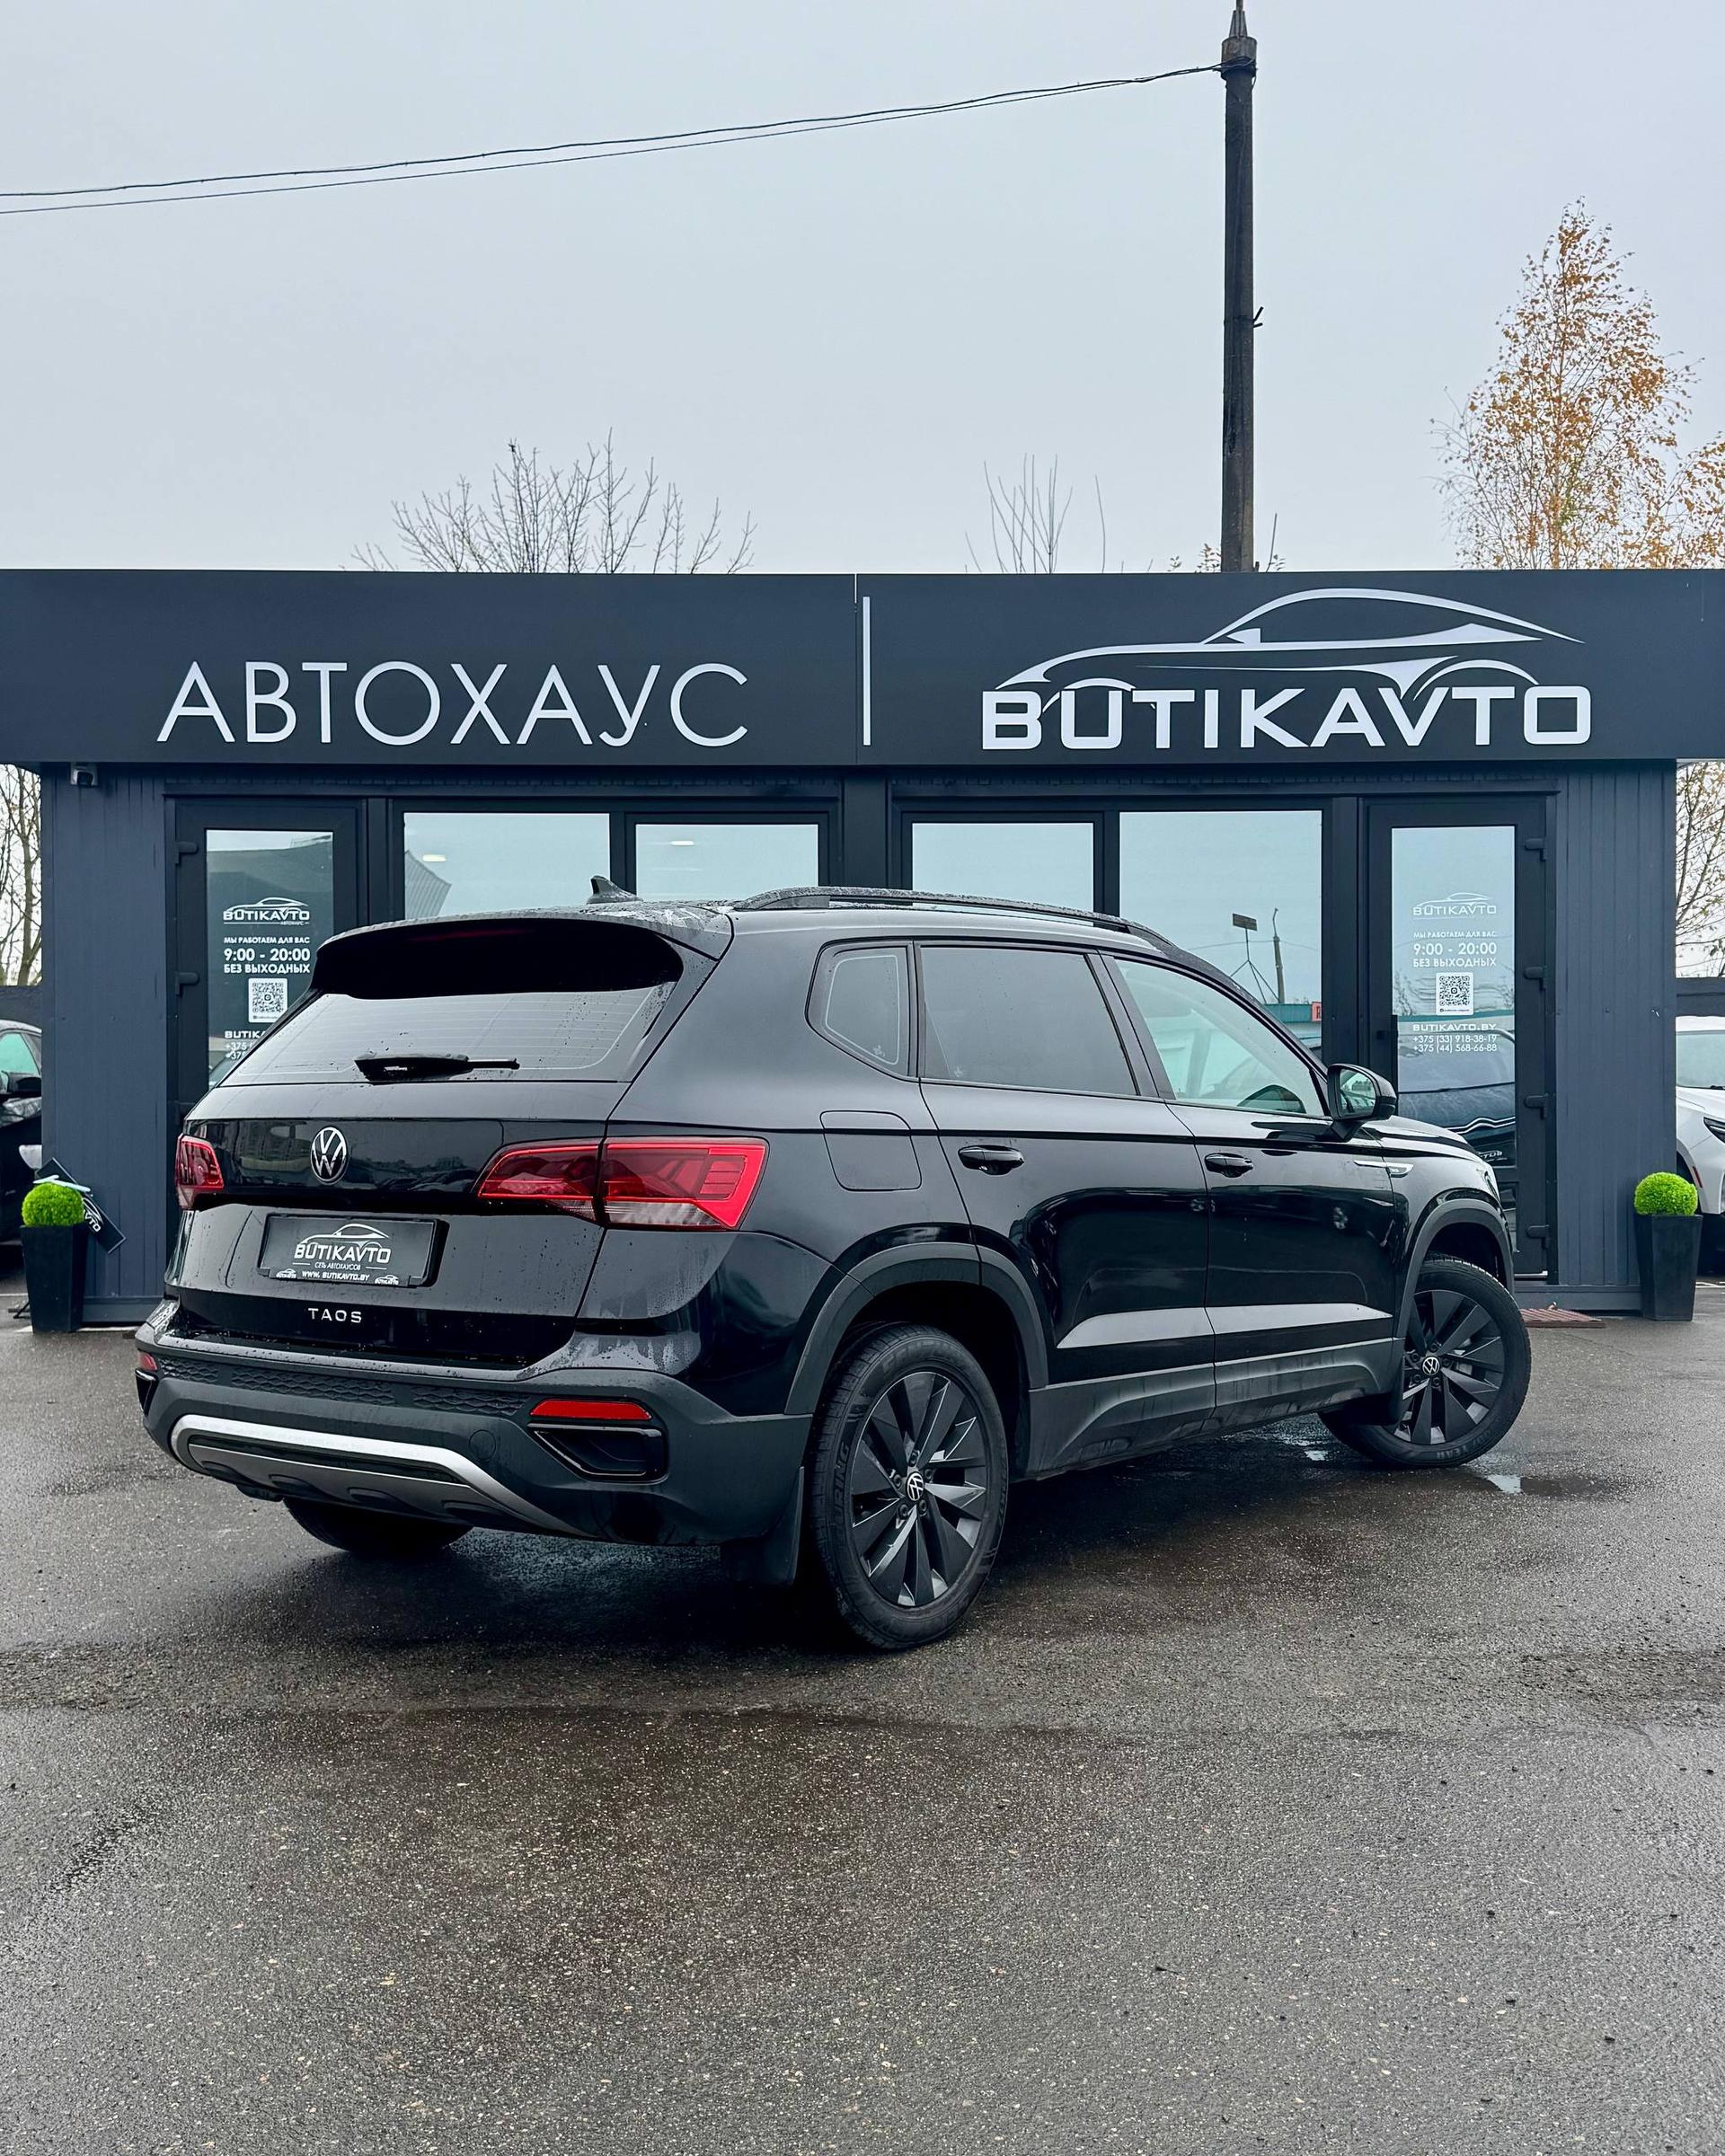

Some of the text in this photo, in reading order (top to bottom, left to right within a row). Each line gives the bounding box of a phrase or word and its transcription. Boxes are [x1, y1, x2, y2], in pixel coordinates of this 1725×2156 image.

[156, 660, 748, 747] АВТОХАУС
[981, 685, 1593, 750] BUTIKAVTO
[223, 910, 310, 921] BUTIKAVTO
[1412, 906, 1498, 915] BUTIKAVTO
[278, 936, 294, 944] ДЛЯ
[1413, 942, 1443, 956] 9:00
[1458, 941, 1498, 955] 20:00
[224, 948, 255, 961] 9:00
[270, 948, 311, 961] 20:00
[224, 963, 311, 974] БЕЗ ВЫХОДНЫХ
[1412, 958, 1497, 968] БЕЗ ВЫХОДНЫХ
[1412, 1023, 1498, 1032] BUTIKAVTO.BY
[1413, 1034, 1497, 1045] +375 (33) 918-38-19
[1413, 1043, 1498, 1054] +375 (44) 568-66-88
[294, 1243, 391, 1264] BUTIKAVTO
[307, 1307, 362, 1324] TAOS
